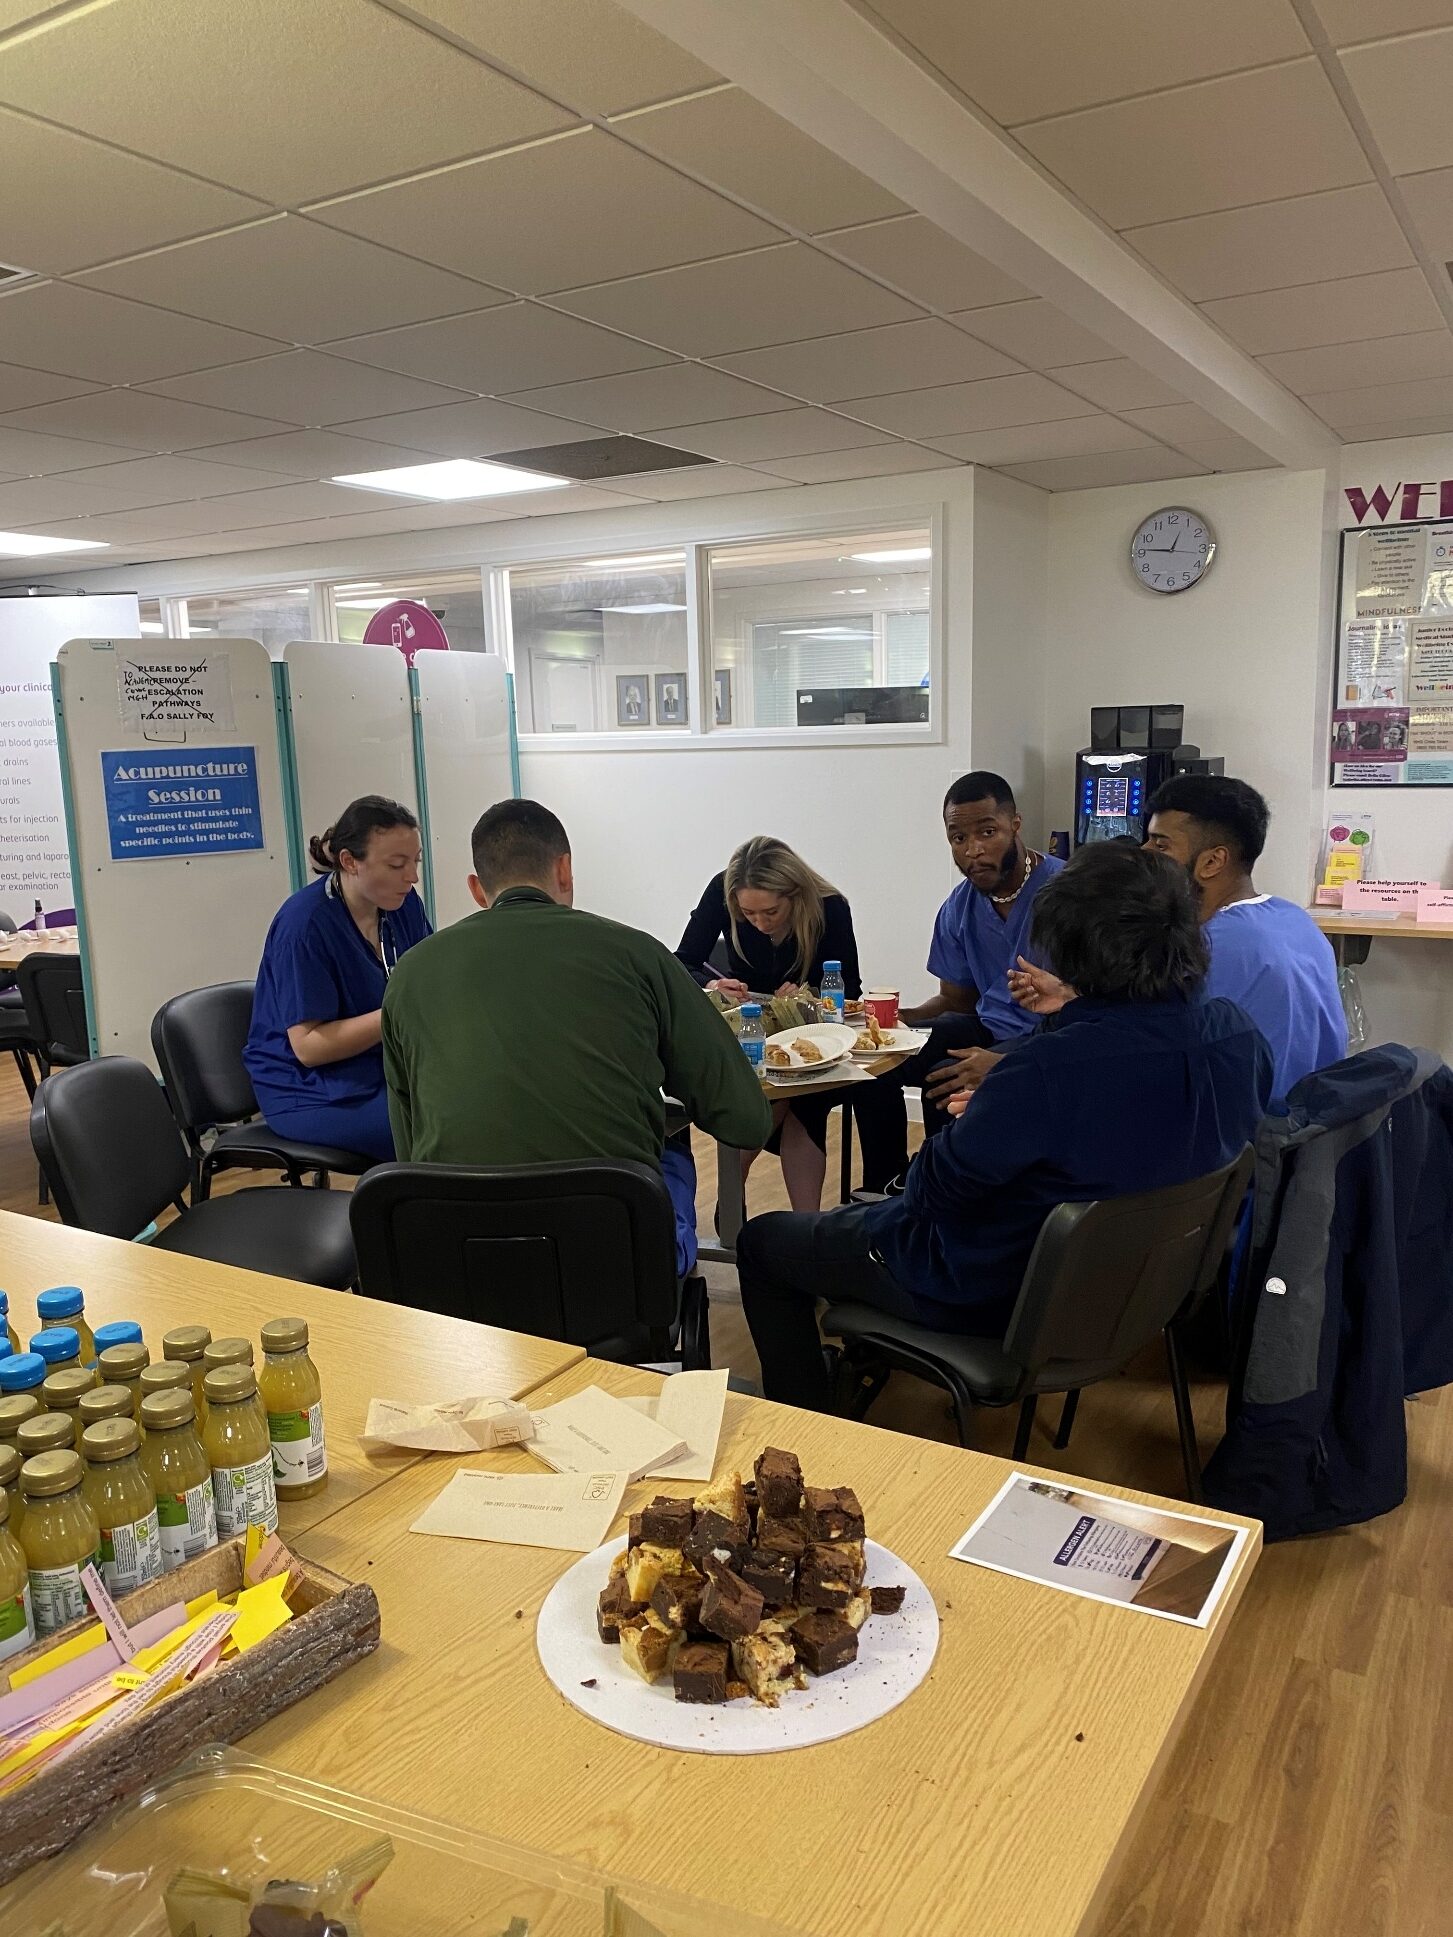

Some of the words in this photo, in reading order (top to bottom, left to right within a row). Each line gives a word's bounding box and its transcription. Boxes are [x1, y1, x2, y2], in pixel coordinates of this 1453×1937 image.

[1168, 514, 1179, 525] 12
[1186, 518, 1190, 527] 1
[1154, 521, 1162, 530] 11
[1194, 528, 1202, 538] 2
[1143, 534, 1153, 543] 10
[1138, 549, 1145, 558] 9
[1199, 544, 1206, 553] 3
[1142, 563, 1150, 572] 8
[1193, 560, 1200, 568] 4
[1152, 574, 1160, 583] 7
[1167, 577, 1175, 586] 6
[1182, 572, 1190, 581] 5
[0, 684, 20, 694] your
[18, 719, 54, 727] available
[34, 739, 58, 748] gases
[4, 758, 28, 766] drains
[114, 762, 248, 780] Acupuncture
[148, 787, 221, 804] Session
[128, 811, 182, 821] treatment
[184, 810, 206, 818] that
[208, 808, 230, 816] uses
[231, 807, 252, 815] thin
[10, 815, 21, 824] for
[24, 815, 58, 825] injection
[136, 825, 176, 834] needles
[189, 820, 239, 830] stimulate
[0, 834, 49, 842] heterisation
[120, 838, 160, 847] specific
[162, 835, 194, 845] points
[228, 831, 254, 840] body.
[26, 852, 41, 860] and
[9, 882, 59, 891] examination
[1059, 1534, 1081, 1562] ALLERGEN
[1076, 1519, 1090, 1536] ALERT
[270, 1544, 286, 1564] beautiful
[87, 1567, 95, 1578] me
[92, 1577, 104, 1597] define
[102, 1596, 113, 1612] them
[113, 1618, 122, 1630] not
[120, 1629, 128, 1639] will
[127, 1642, 136, 1653] but
